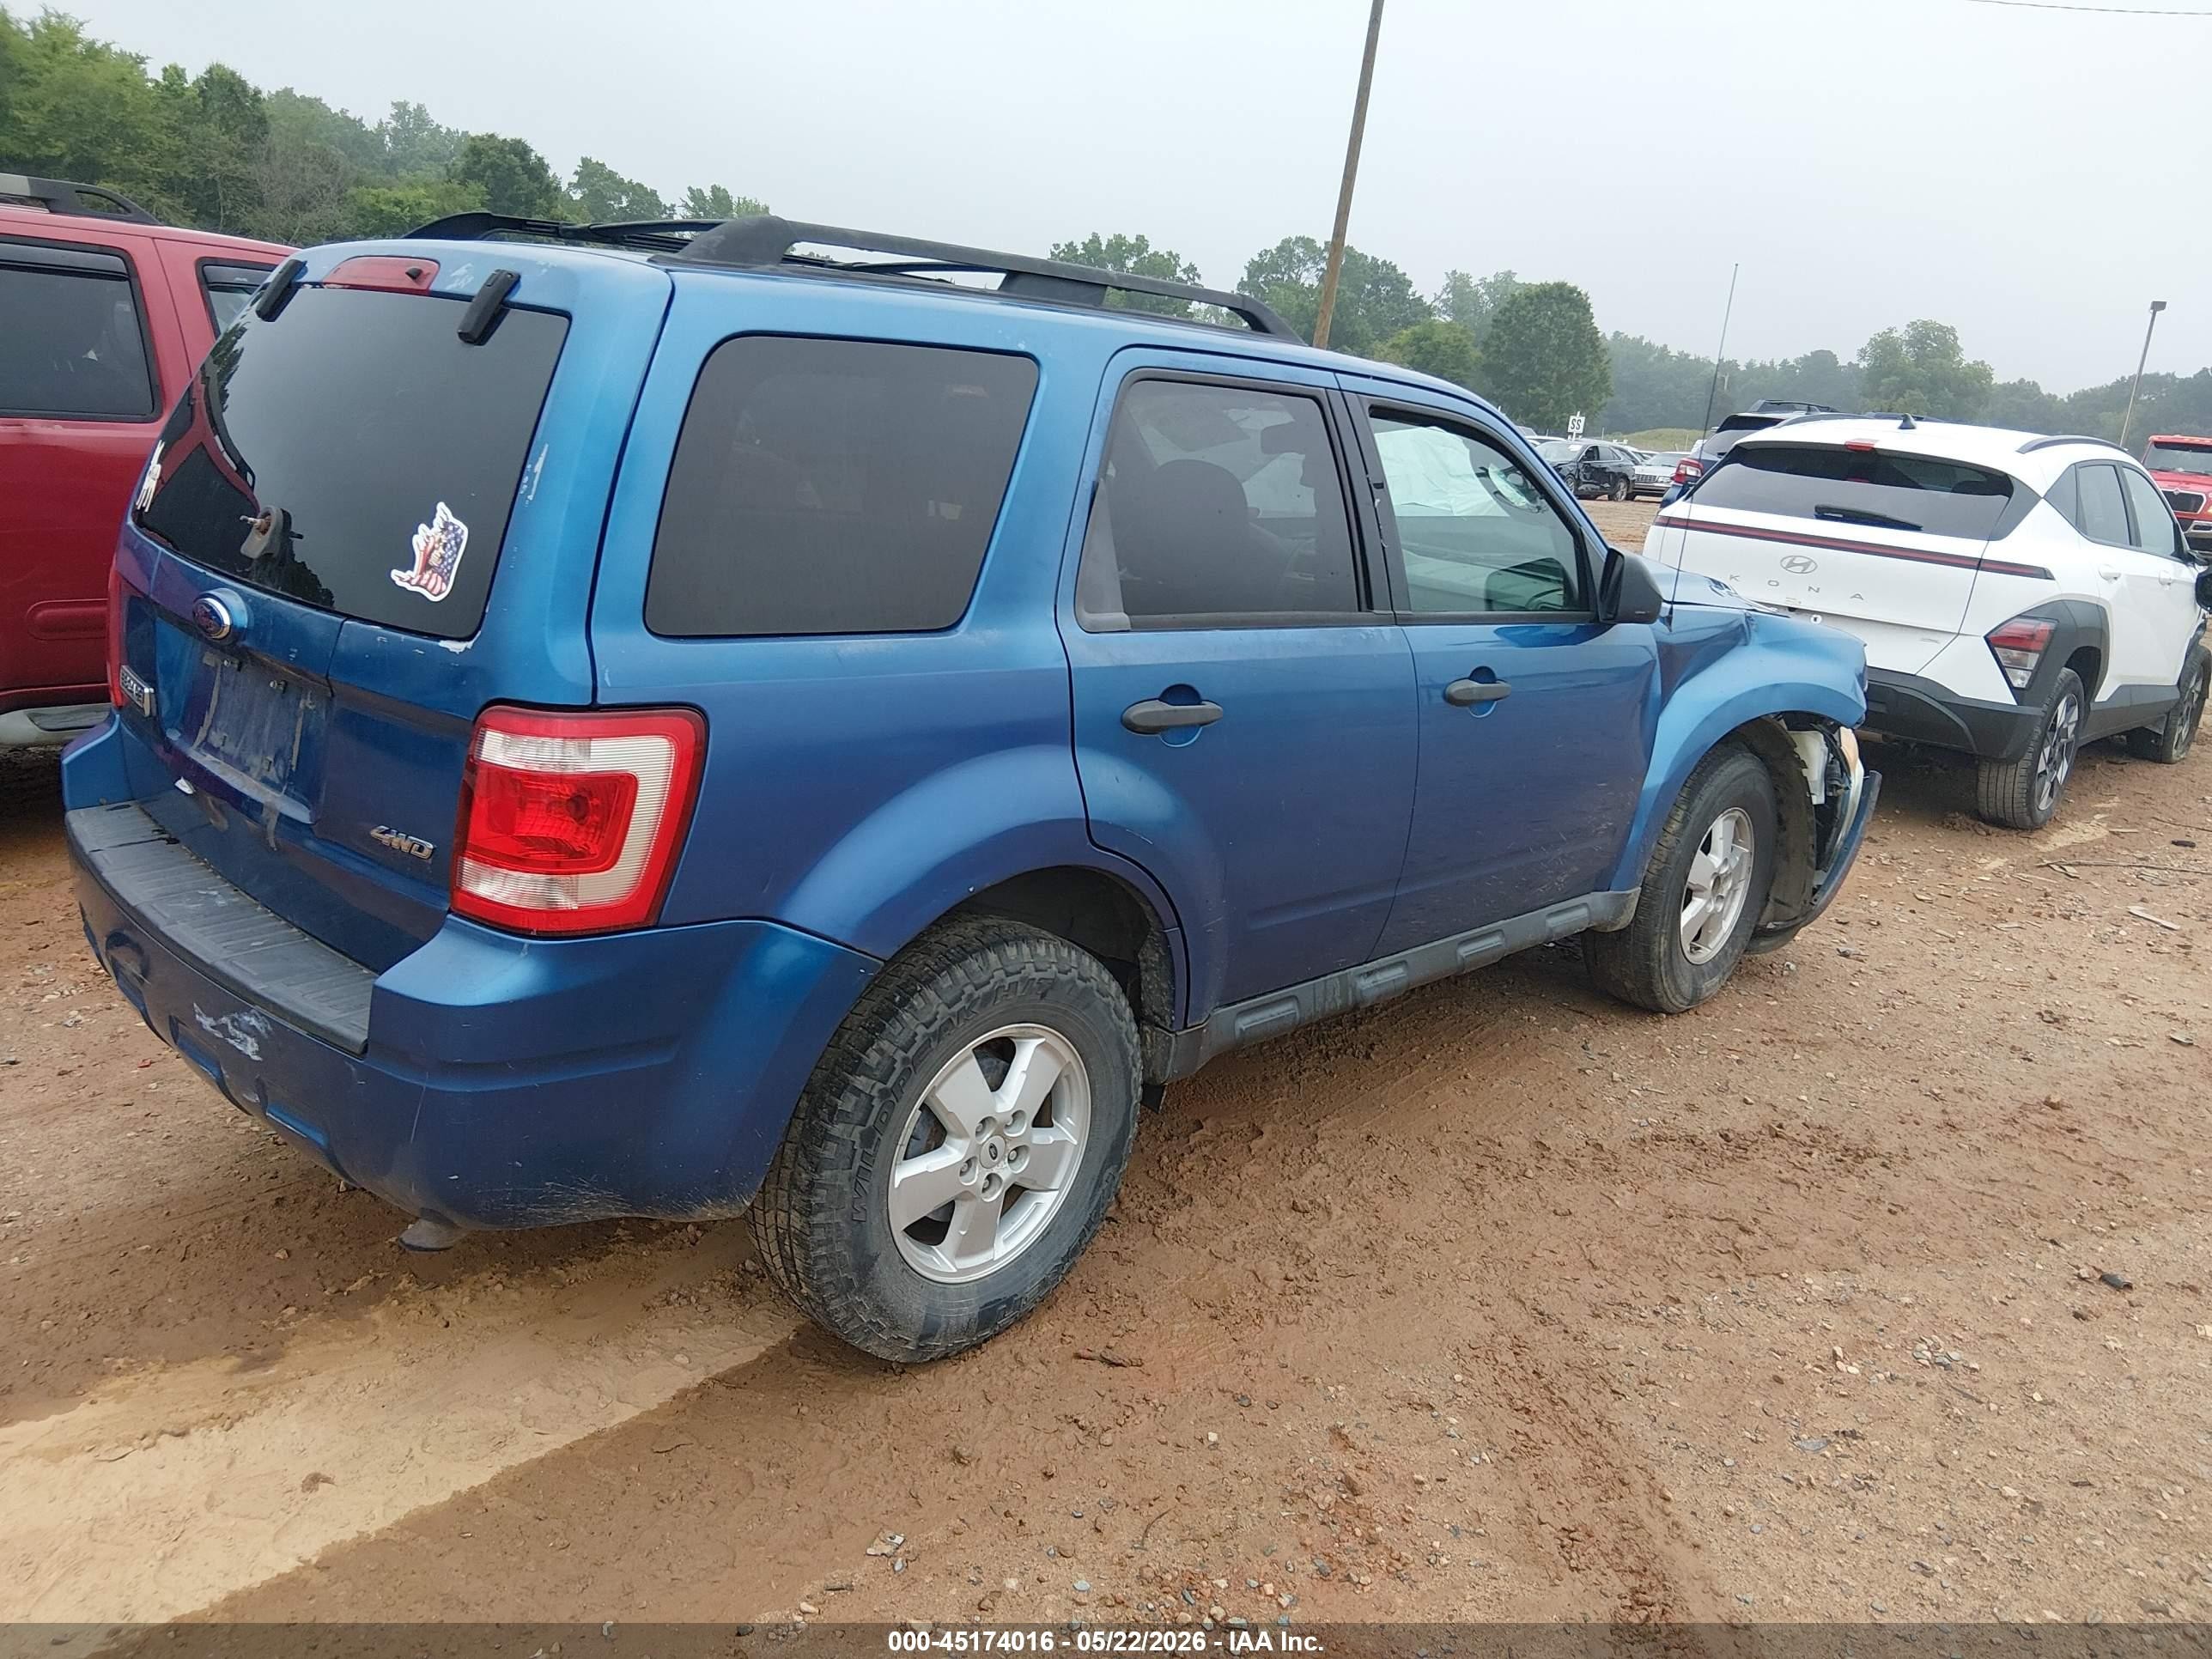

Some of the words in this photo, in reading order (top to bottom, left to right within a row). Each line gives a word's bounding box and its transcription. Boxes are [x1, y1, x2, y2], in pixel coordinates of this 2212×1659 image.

[1570, 418, 1582, 431] SS
[1729, 574, 1864, 601] KONA
[370, 825, 434, 860] 4WD
